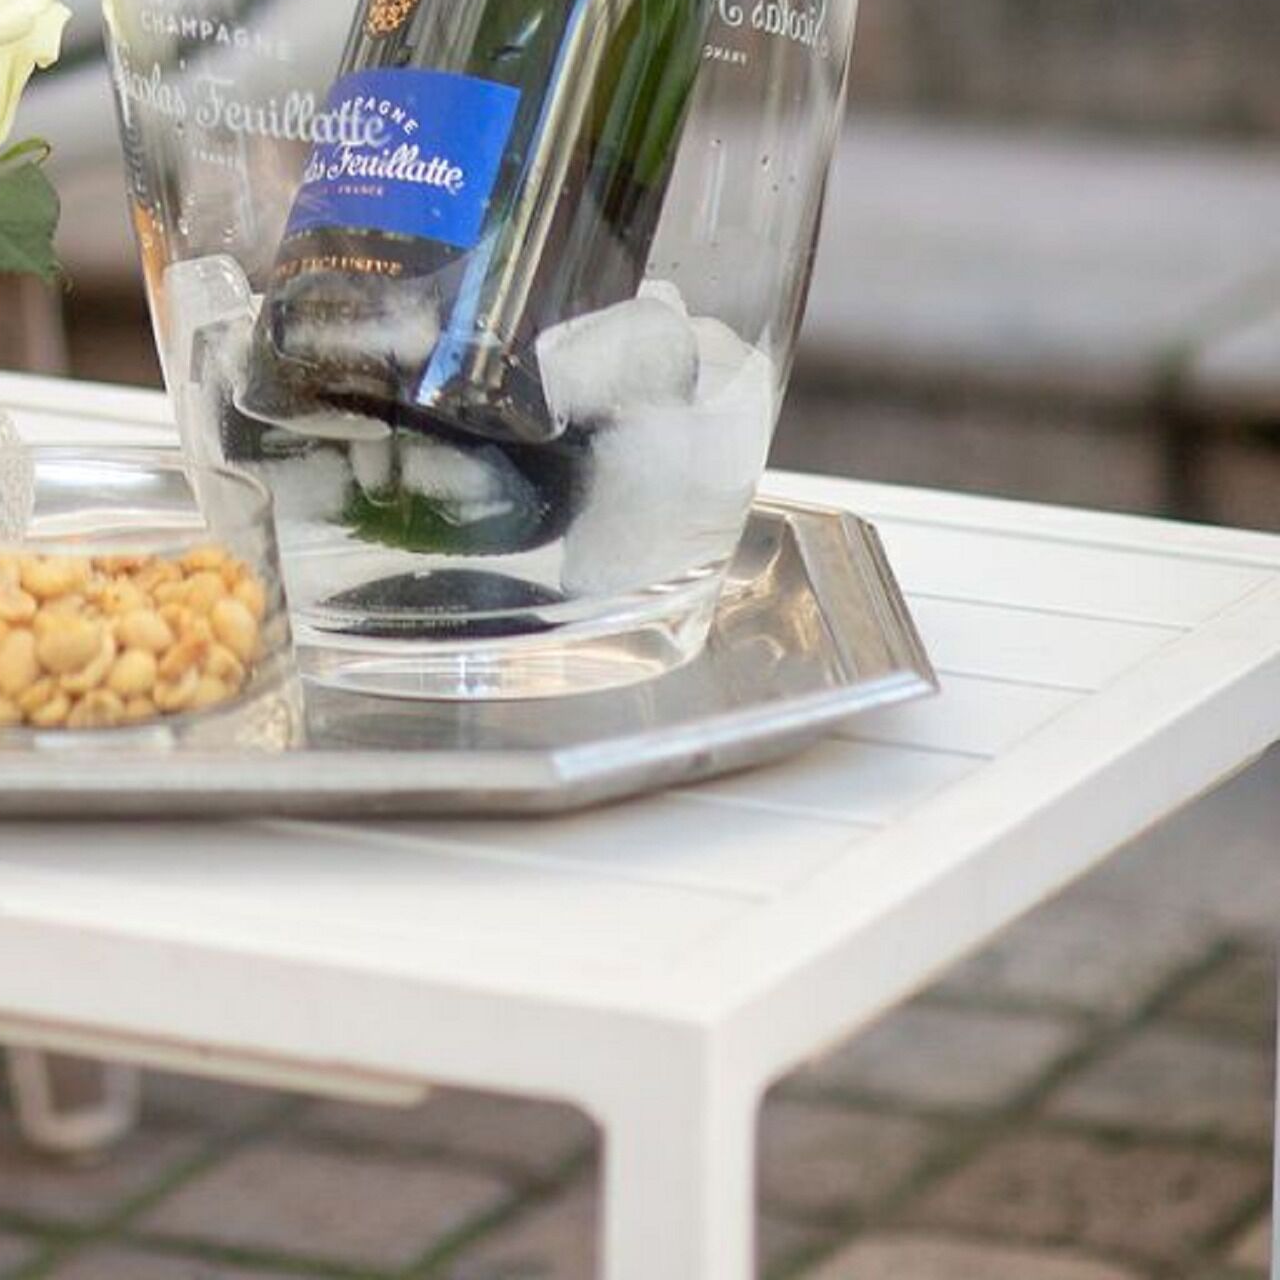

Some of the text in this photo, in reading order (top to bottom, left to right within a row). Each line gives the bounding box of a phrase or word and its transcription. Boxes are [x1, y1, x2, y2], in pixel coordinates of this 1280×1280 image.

[140, 8, 292, 62] CHAMPAGNE
[193, 74, 394, 148] Feuillatte
[326, 142, 465, 196] Feuillatte
